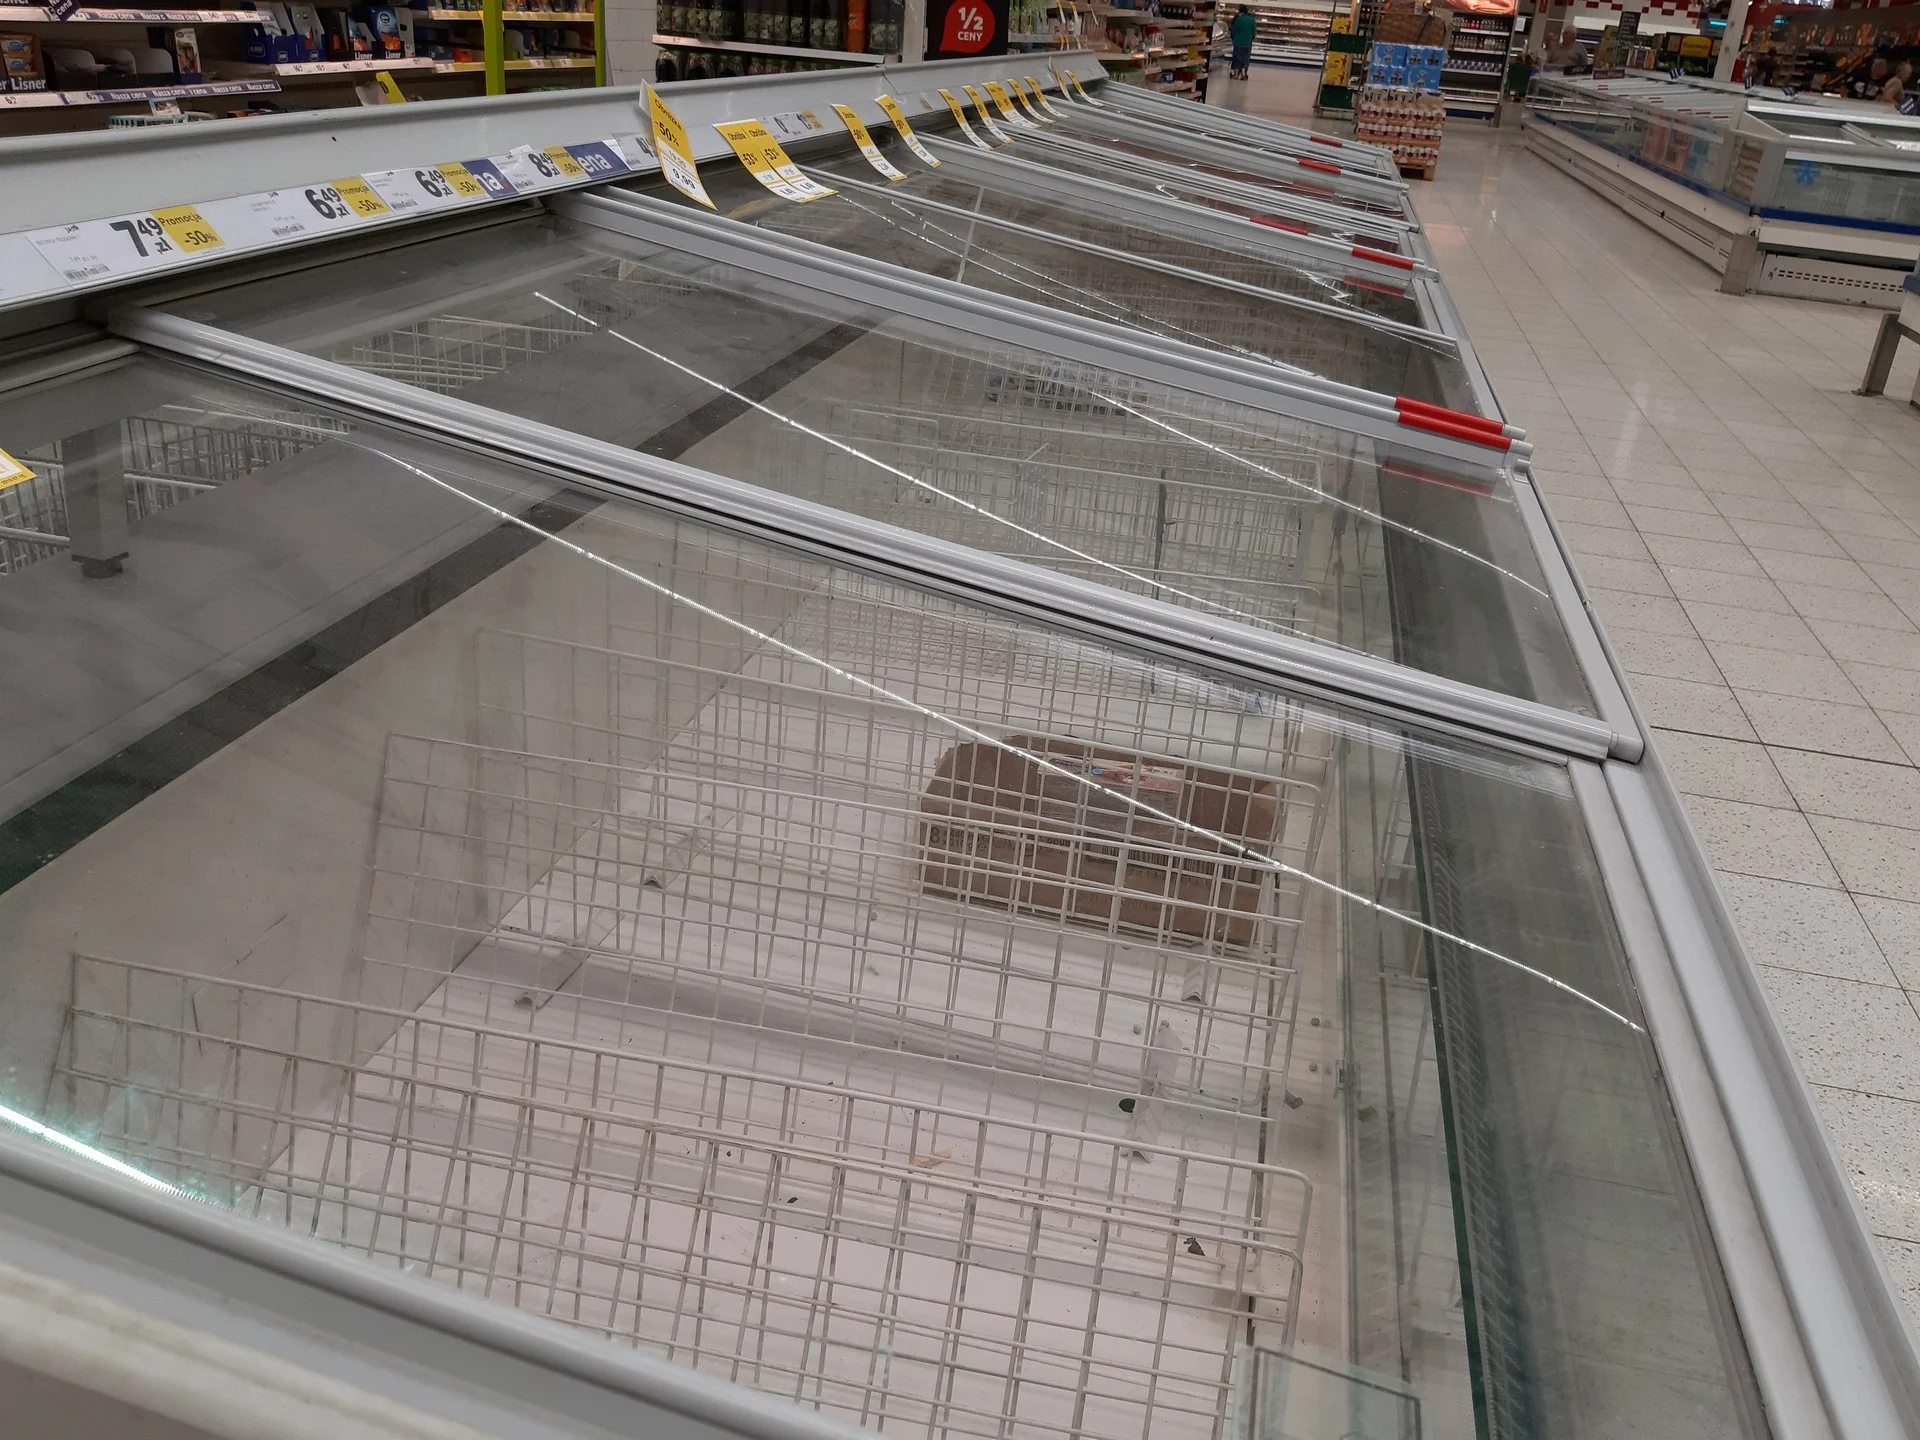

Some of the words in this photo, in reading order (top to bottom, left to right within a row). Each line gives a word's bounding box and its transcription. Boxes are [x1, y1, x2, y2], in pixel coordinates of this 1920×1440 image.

[958, 7, 984, 31] 1/2
[957, 31, 983, 42] CENY
[10, 77, 47, 91] Lisner
[227, 84, 242, 93] cena
[246, 82, 262, 91] Nasza
[262, 82, 276, 91] cena
[654, 120, 680, 147] -50%
[442, 167, 469, 178] Promocja
[335, 184, 370, 196] Promocja
[158, 211, 203, 227] Promocja
[184, 230, 217, 246] -50%
